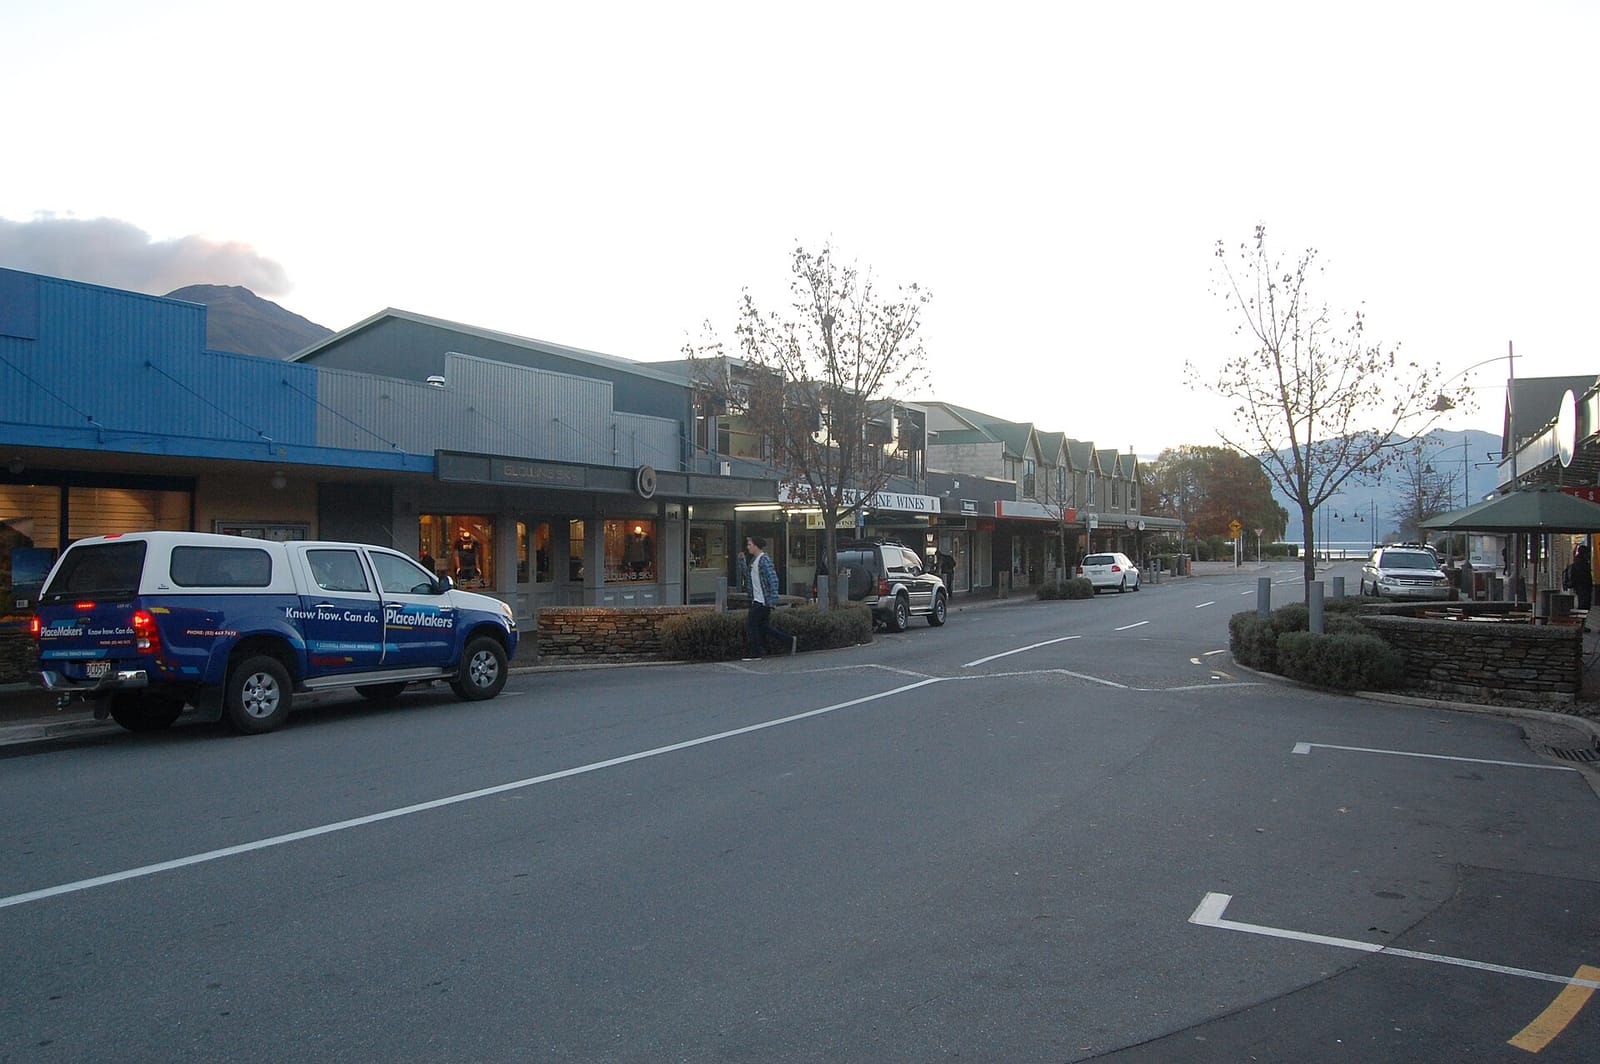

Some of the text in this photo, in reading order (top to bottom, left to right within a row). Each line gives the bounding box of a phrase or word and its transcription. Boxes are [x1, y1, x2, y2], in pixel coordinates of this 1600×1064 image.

[870, 493, 892, 508] INE
[896, 495, 925, 510] WINES
[286, 607, 379, 623] Know how. Can do.
[386, 608, 453, 629] PlaceMakers
[40, 625, 83, 637] PlaceMakers
[87, 628, 102, 636] Know
[115, 627, 126, 635] Can
